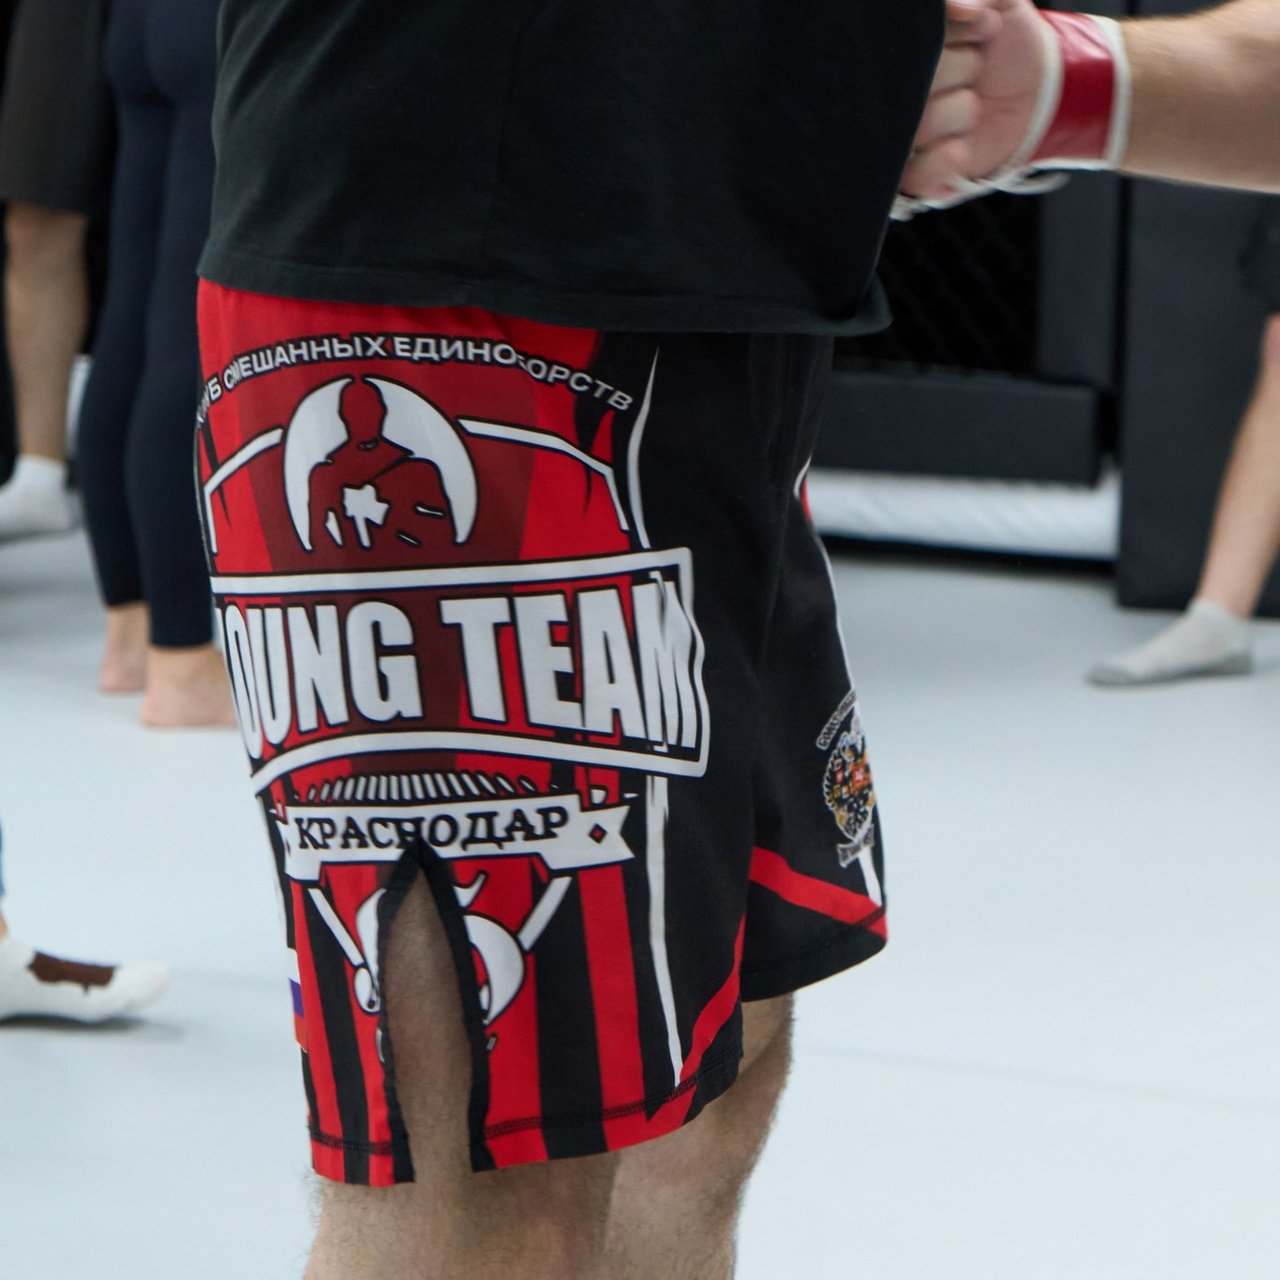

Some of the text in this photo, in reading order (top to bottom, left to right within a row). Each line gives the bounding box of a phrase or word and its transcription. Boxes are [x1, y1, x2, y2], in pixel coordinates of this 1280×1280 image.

[392, 335, 634, 412] ЕДИНООРСТВ
[215, 578, 697, 760] OUNG TEAM
[294, 805, 569, 852] КРАСНОДАР
